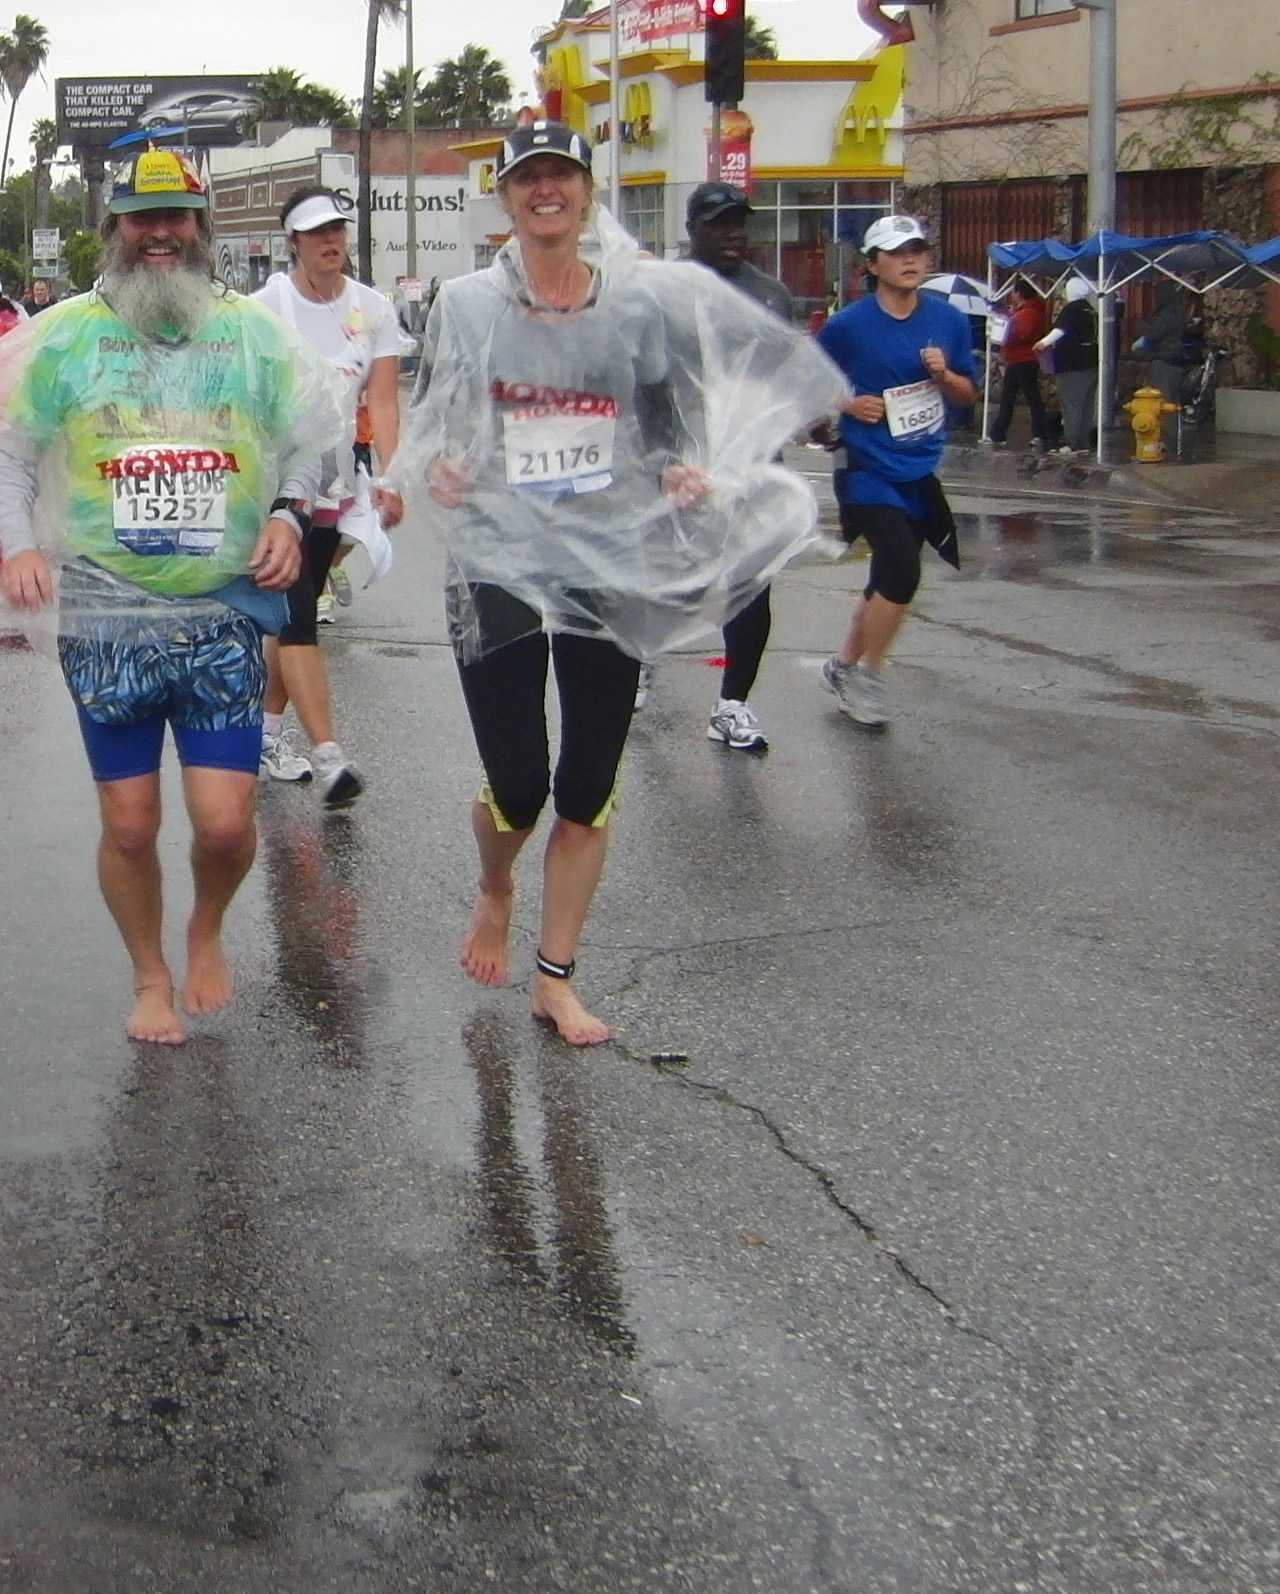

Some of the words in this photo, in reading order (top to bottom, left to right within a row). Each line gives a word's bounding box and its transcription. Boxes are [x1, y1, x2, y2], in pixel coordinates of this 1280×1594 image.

[65, 96, 89, 106] THAT
[91, 96, 123, 105] KILLED
[126, 96, 144, 105] THE
[66, 86, 83, 95] THE
[86, 85, 131, 95] COMPACT
[133, 84, 153, 94] CAR
[66, 107, 110, 117] COMPACT
[112, 106, 135, 117] CAR.
[334, 187, 465, 212] Slutons!
[898, 402, 940, 429] 16827
[95, 451, 240, 480] HONDA
[519, 444, 599, 475] 21176
[115, 463, 177, 498] KEN
[127, 498, 214, 521] 15257
